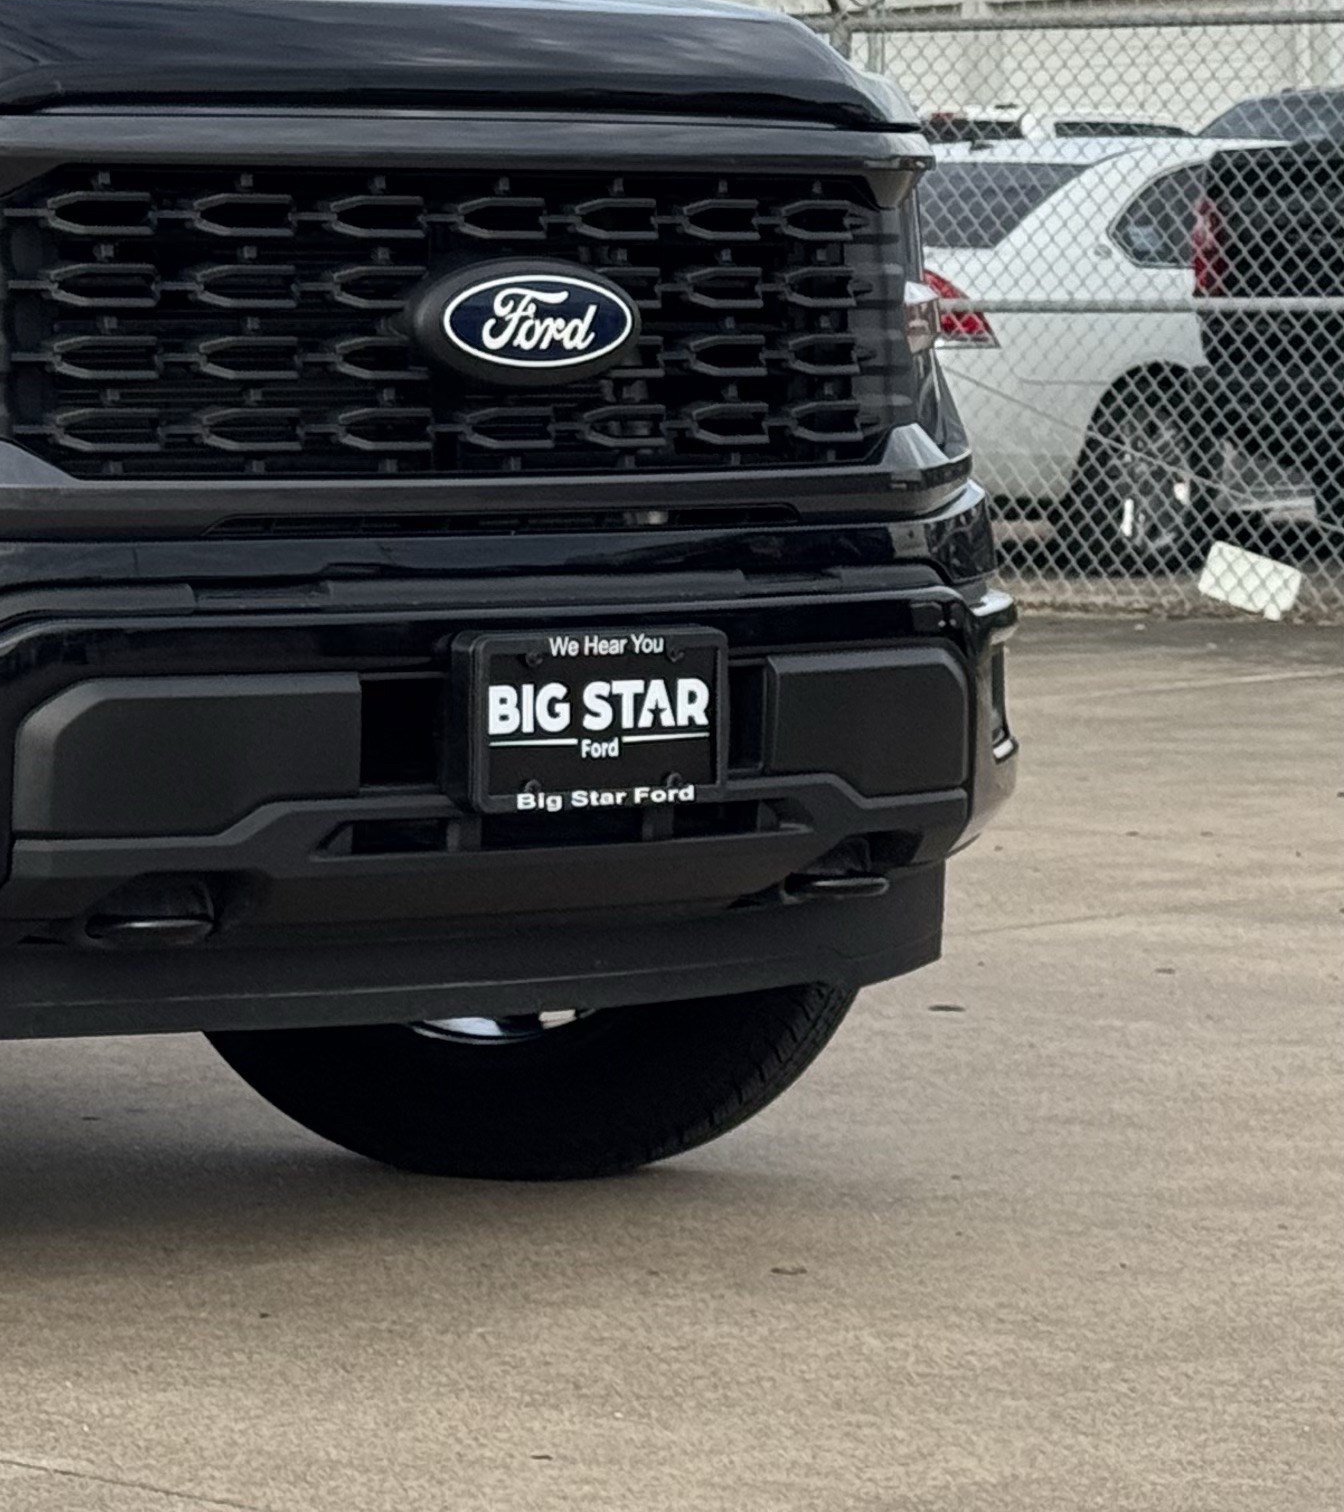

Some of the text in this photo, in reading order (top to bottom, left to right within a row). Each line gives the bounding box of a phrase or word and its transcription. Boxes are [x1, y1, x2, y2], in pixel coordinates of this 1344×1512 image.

[481, 287, 597, 350] Ford
[549, 633, 664, 656] We Hear You
[488, 678, 710, 735] BIG STAR
[581, 738, 619, 758] Ford
[517, 785, 695, 812] Big Star Ford
